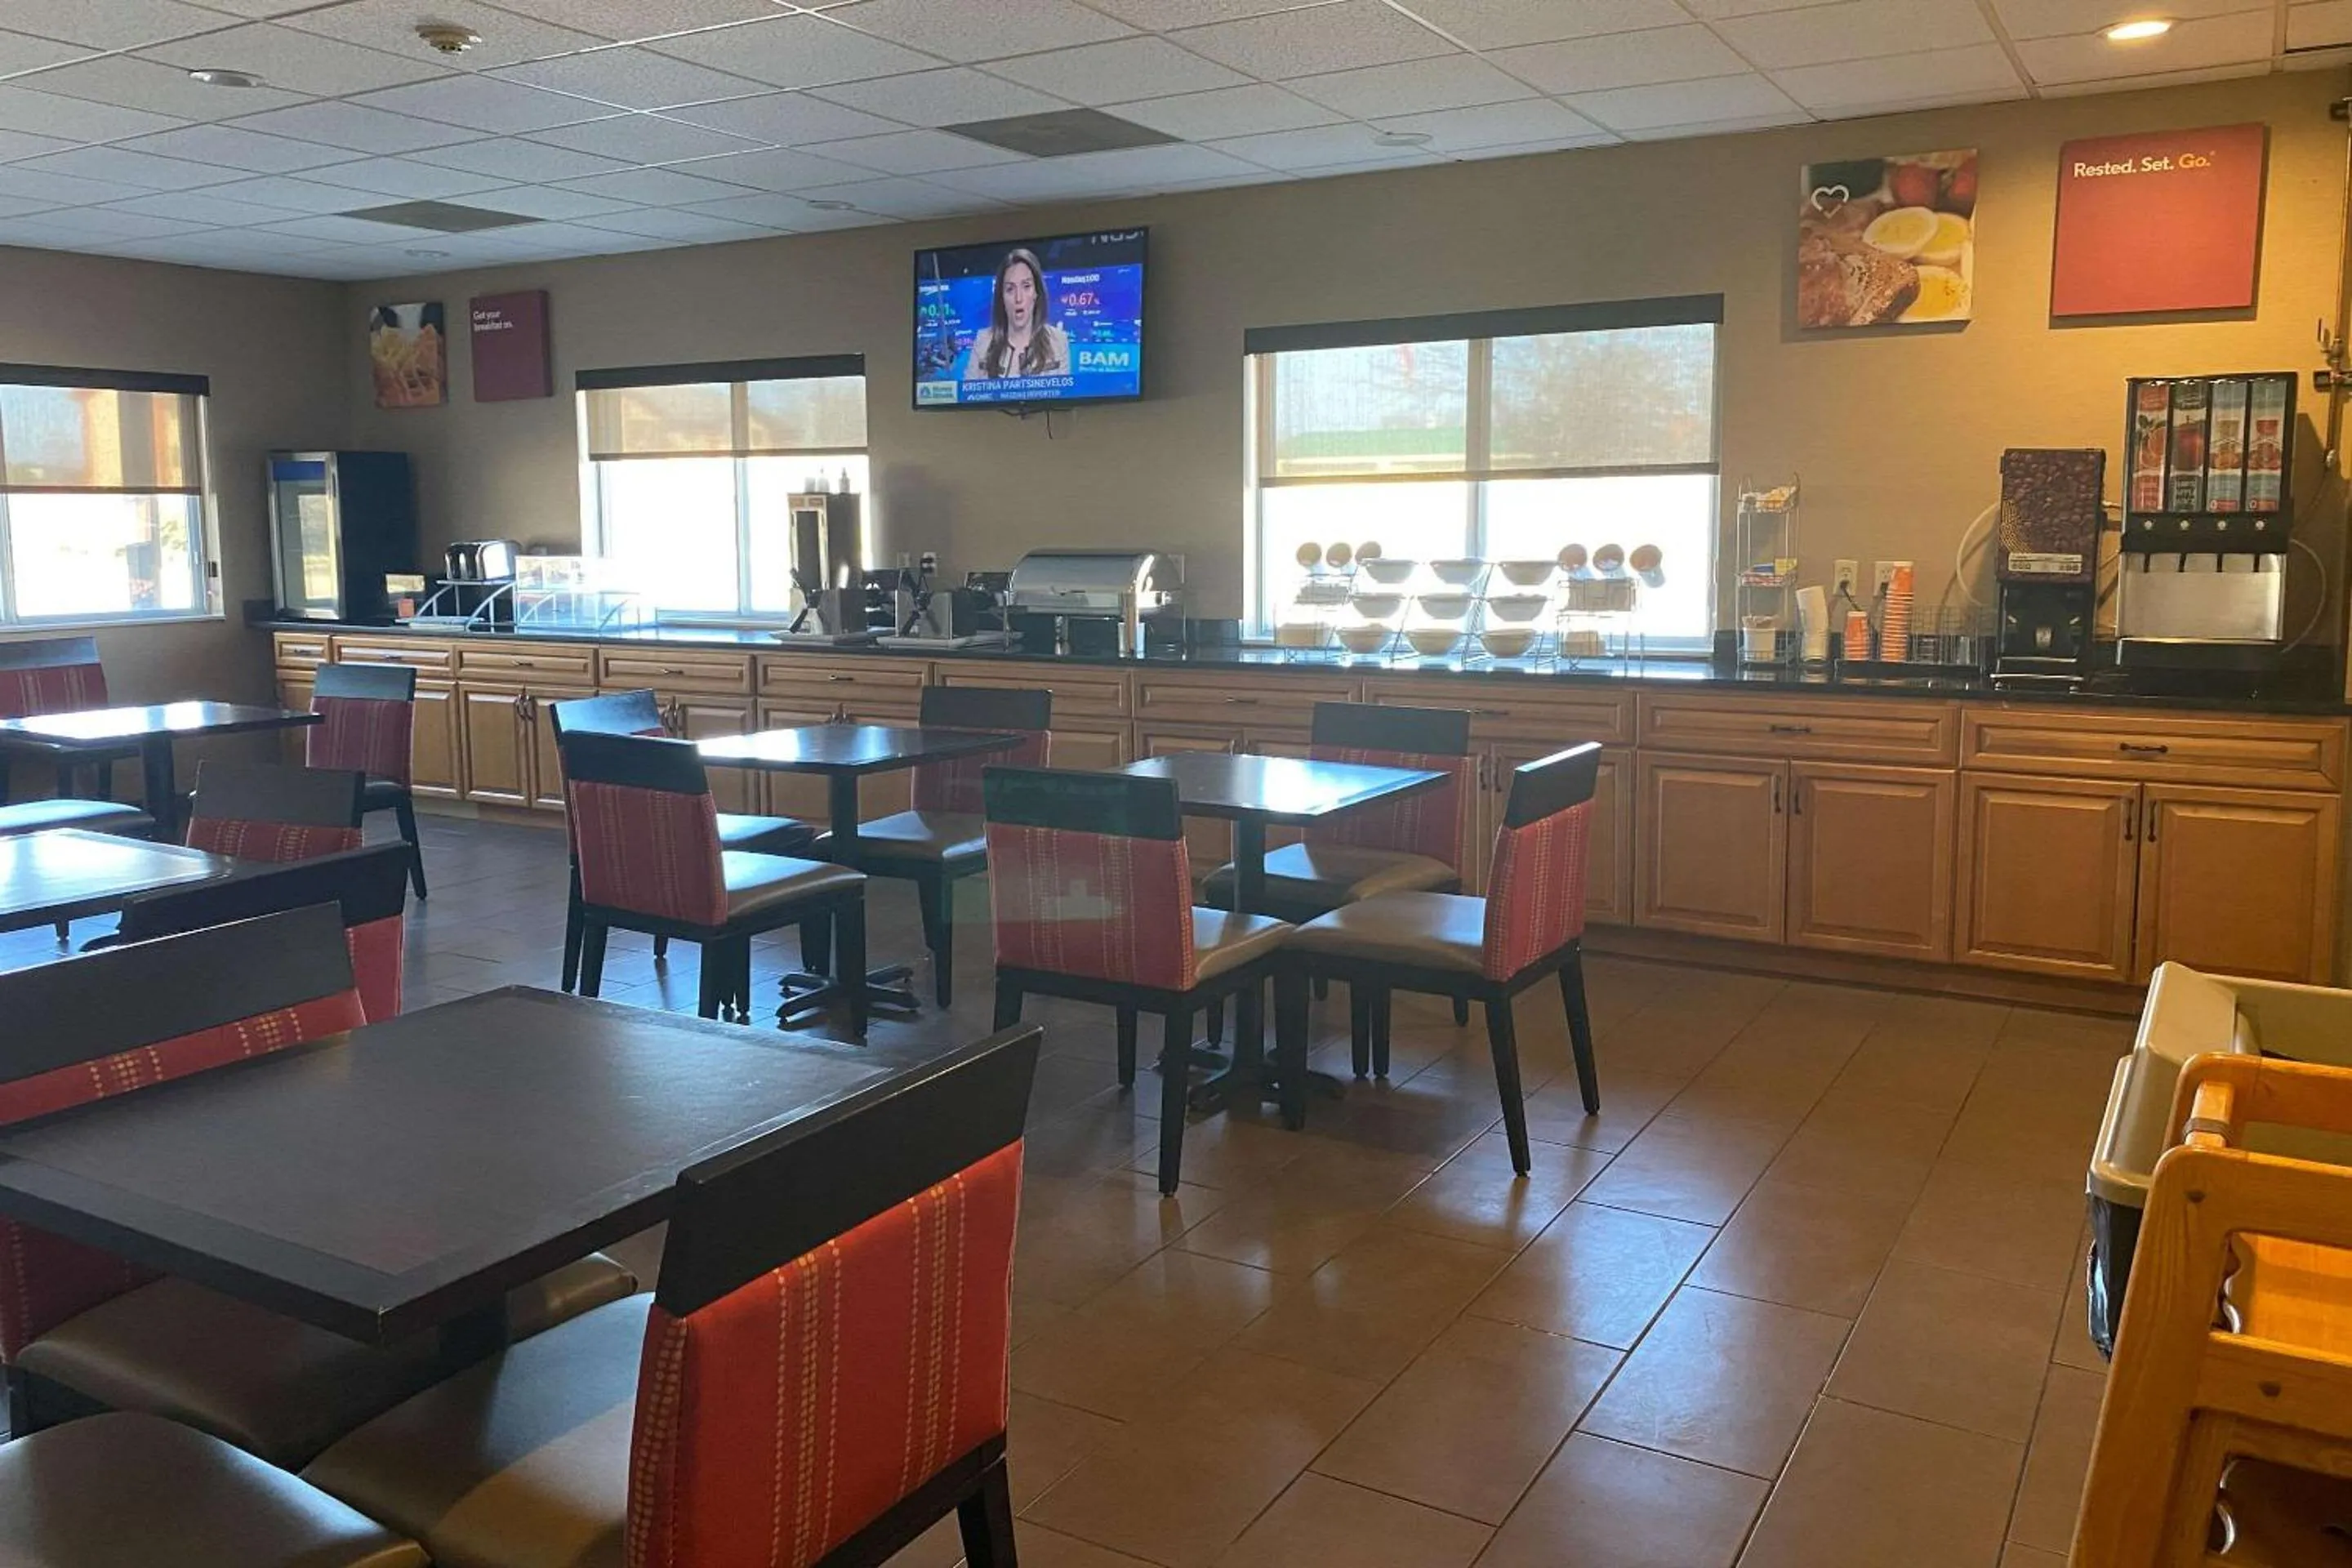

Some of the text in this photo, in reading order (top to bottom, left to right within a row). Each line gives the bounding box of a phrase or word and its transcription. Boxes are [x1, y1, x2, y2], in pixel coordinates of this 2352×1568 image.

[2074, 153, 2211, 178] Rested. Set. Go.
[473, 310, 501, 320] Get your
[1079, 350, 1130, 367] BAM
[962, 380, 1001, 392] KRISTINA
[1003, 376, 1074, 390] PARTSINEVELOS
